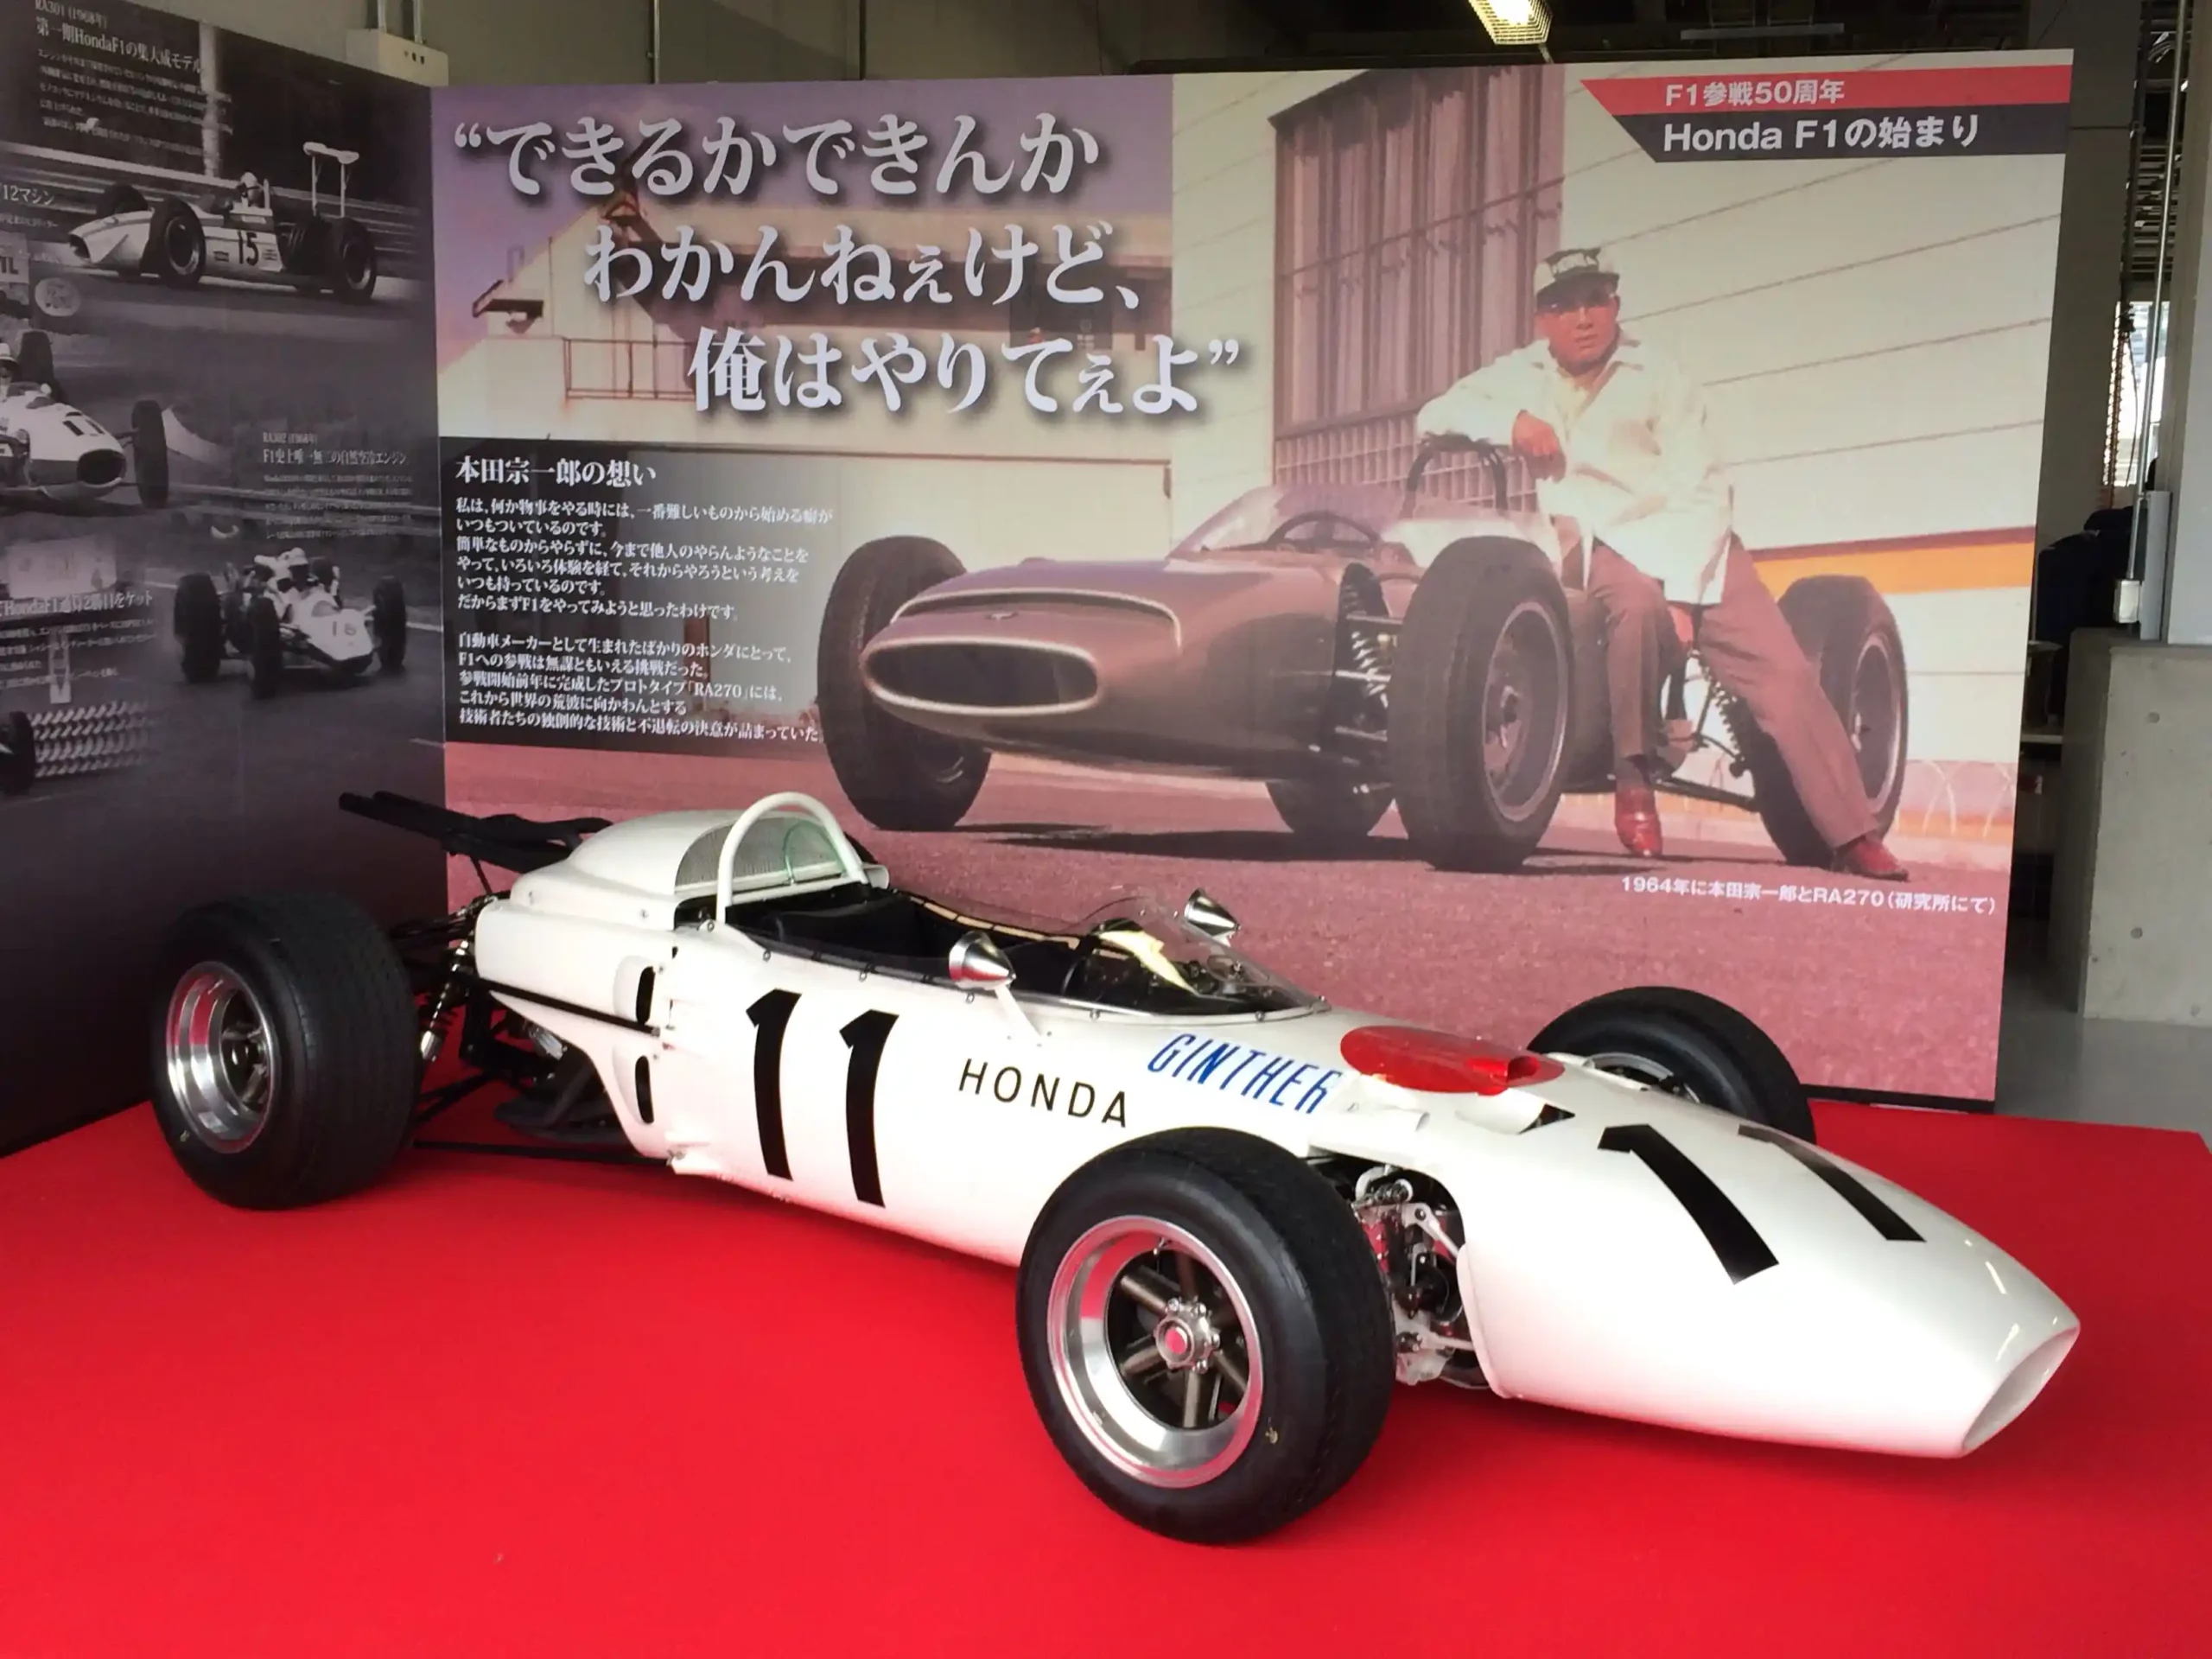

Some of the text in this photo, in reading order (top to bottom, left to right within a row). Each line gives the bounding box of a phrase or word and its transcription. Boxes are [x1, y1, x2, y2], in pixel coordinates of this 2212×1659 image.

[1665, 79, 1845, 107] F1参戦50周年
[1663, 113, 1980, 152] Honda F1の始まり
[583, 221, 1140, 308] わかんねぇけど、
[455, 454, 657, 486] 本田宗一郎の想い
[456, 518, 607, 537] いつもついているのです。
[457, 575, 606, 596] いつも持っているのです。
[746, 988, 899, 1208] 11
[959, 1057, 1128, 1128] HONDA
[1597, 1123, 1927, 1285] 11
